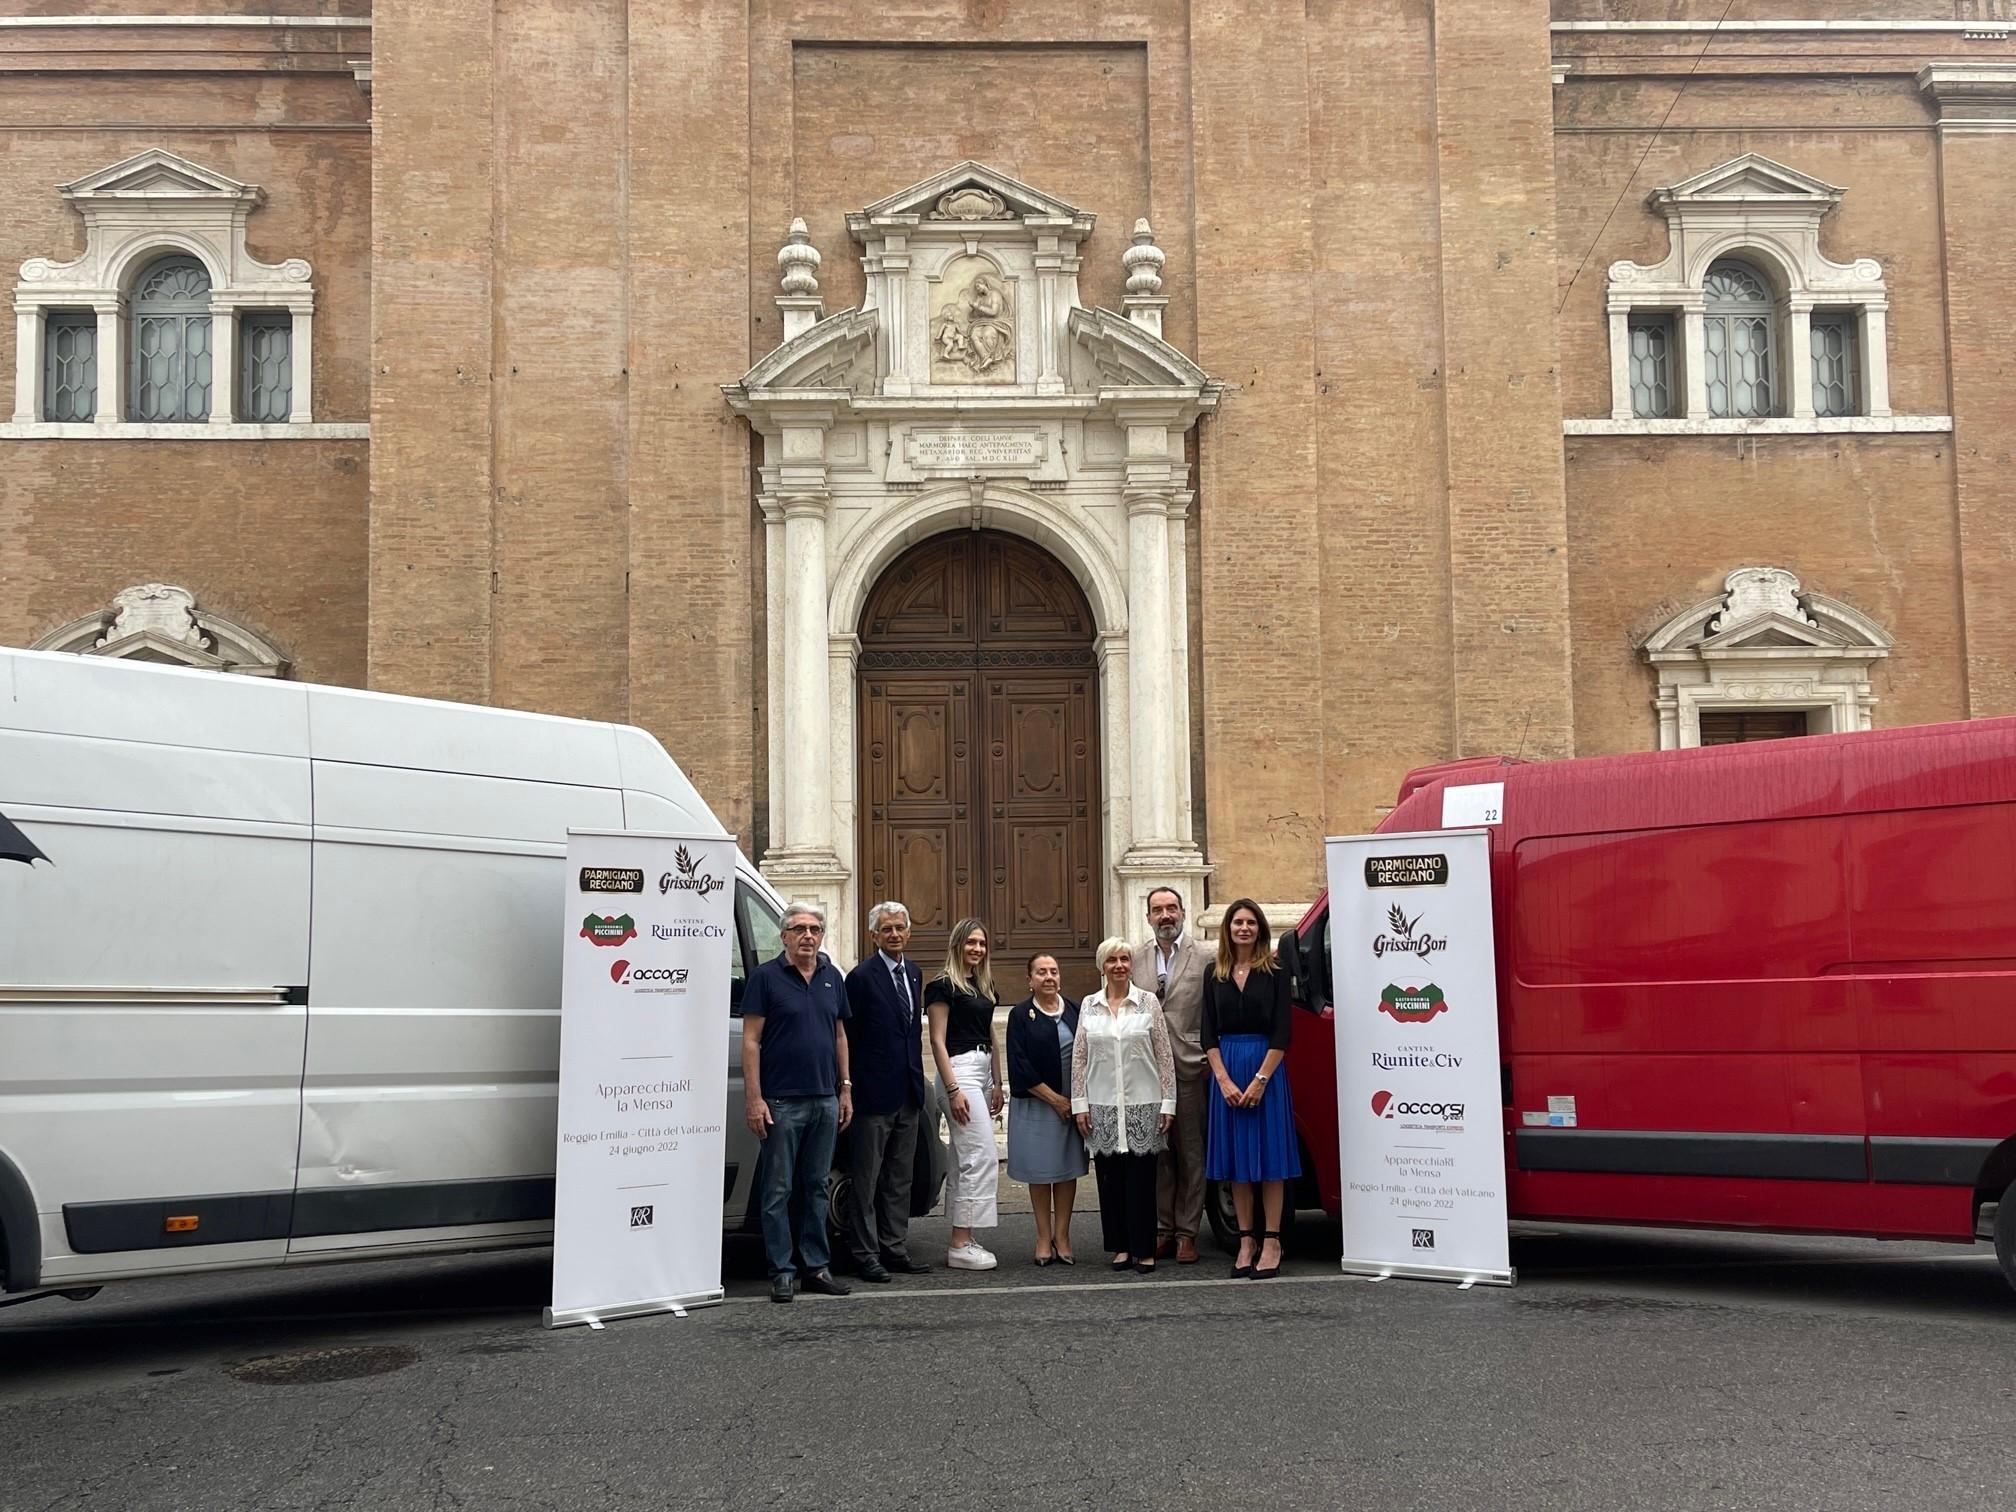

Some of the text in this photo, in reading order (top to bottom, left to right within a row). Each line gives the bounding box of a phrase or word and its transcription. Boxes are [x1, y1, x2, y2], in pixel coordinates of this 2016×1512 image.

[1485, 809, 1497, 821] 22
[1370, 857, 1441, 872] PARMIGIANO
[584, 869, 640, 880] PARMIGIANO
[1378, 870, 1435, 883] REGGIANO
[590, 879, 634, 890] REGGIANO
[658, 872, 725, 896] GrissinBon
[1373, 933, 1447, 958] GrissinBon
[595, 1079, 695, 1099] ApparecchiaRE
[617, 1099, 673, 1112] la Mensa
[563, 1133, 598, 1145] Reggio
[600, 1130, 628, 1141] Emilia
[638, 1128, 661, 1138] Città
[664, 1125, 678, 1136] del
[680, 1124, 721, 1135] Vaticano
[609, 1141, 678, 1156] 24 giugno 2022
[1400, 1167, 1441, 1178] la Mensa
[1350, 1182, 1379, 1192] Reggio
[1380, 1183, 1406, 1193] Emilia
[1414, 1185, 1436, 1195] Città
[1439, 1186, 1453, 1196] del
[1455, 1187, 1495, 1198] Vaticano
[1390, 1197, 1454, 1209] 24 giugno 2022
